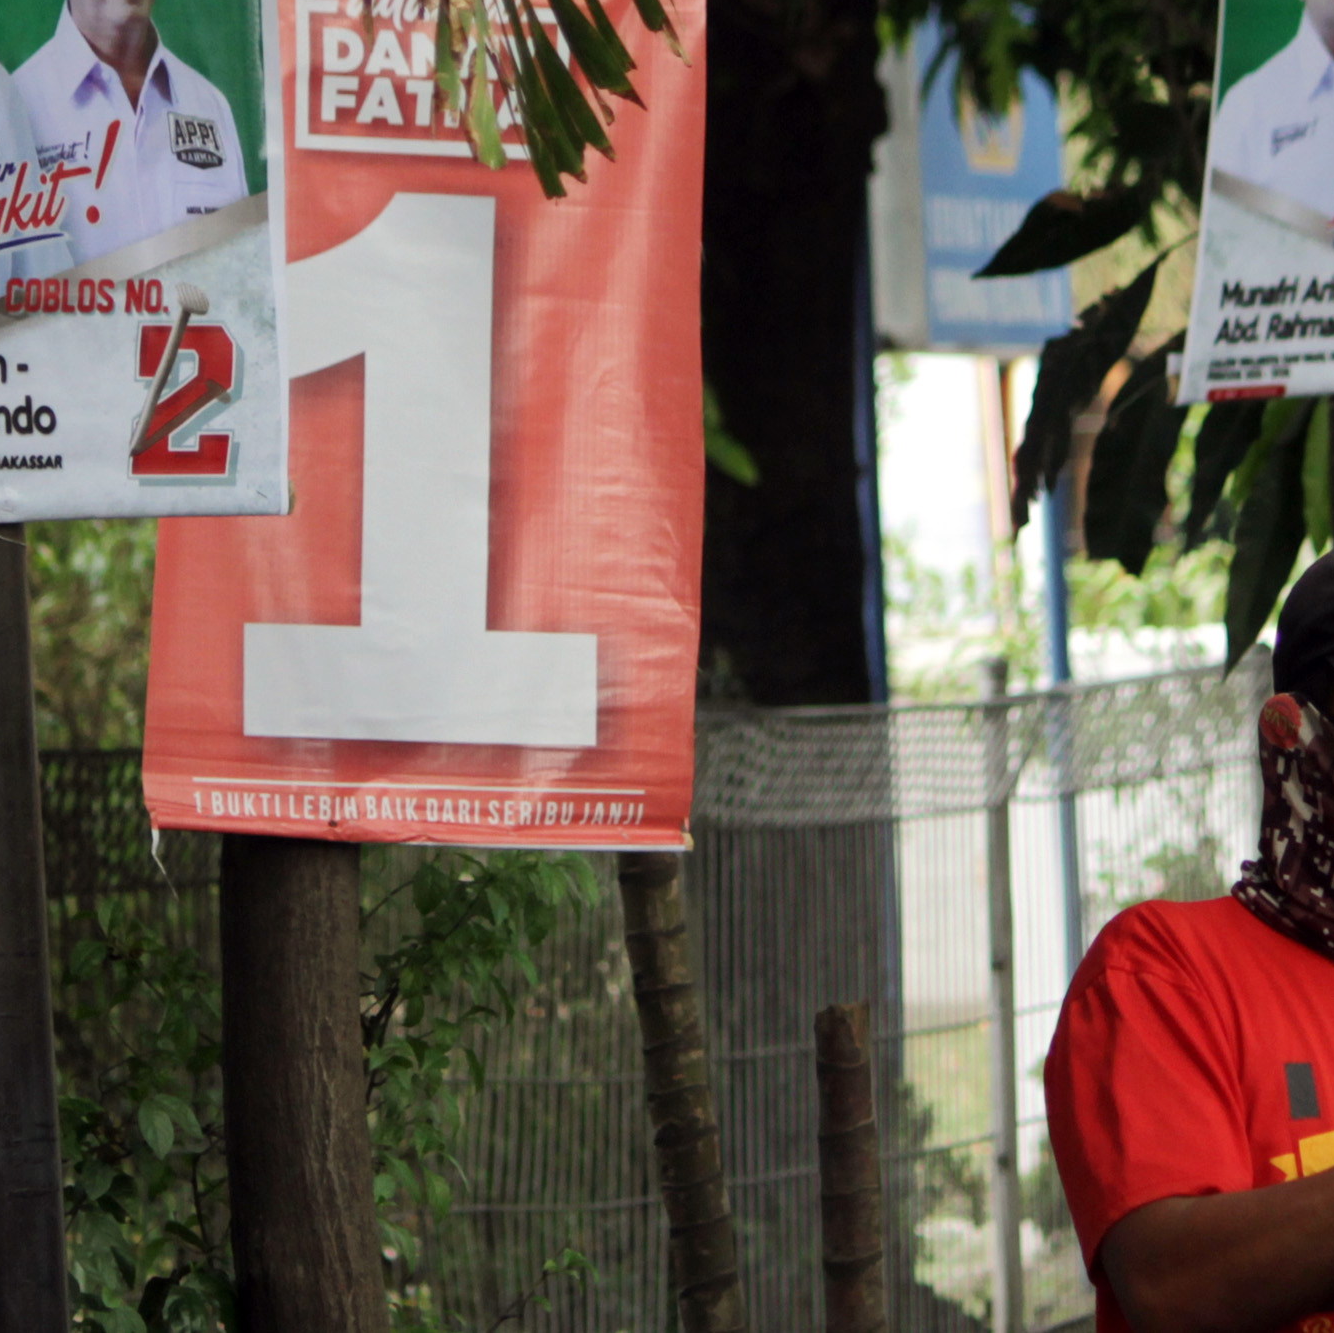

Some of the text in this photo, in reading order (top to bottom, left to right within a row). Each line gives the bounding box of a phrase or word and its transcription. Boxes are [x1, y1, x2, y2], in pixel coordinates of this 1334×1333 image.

[174, 119, 221, 151] APPI
[5, 278, 170, 314] COBLOS NO.
[1220, 276, 1299, 309] Munafri
[131, 324, 234, 478] 2
[243, 192, 597, 746] 1
[211, 791, 281, 818] BUKTI
[289, 794, 358, 821] LEBIH
[366, 796, 418, 823] BAIK
[426, 798, 481, 824] DARI
[488, 800, 573, 827] SERIBU
[579, 802, 644, 827] JANJI
